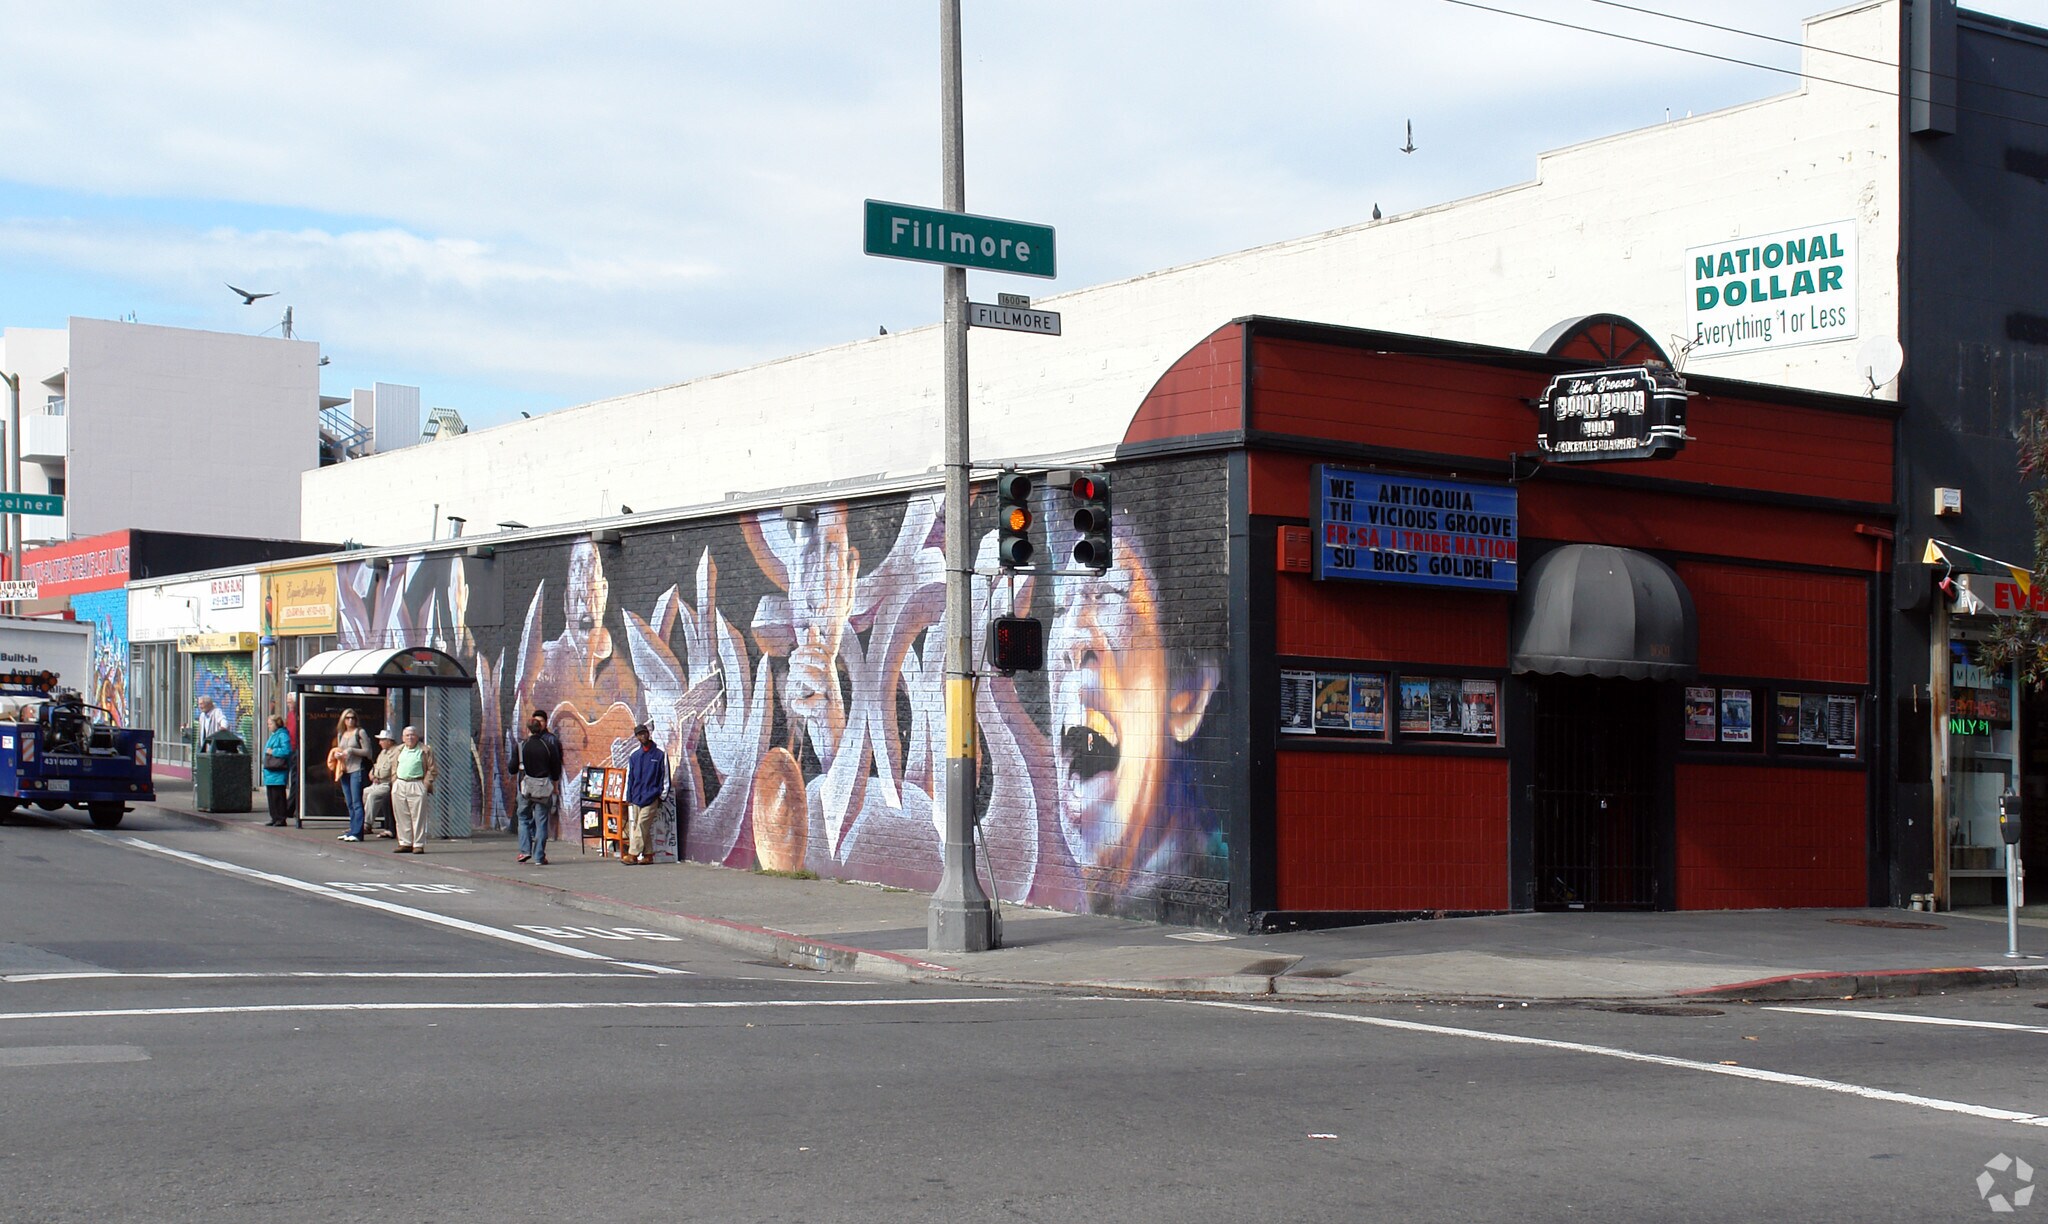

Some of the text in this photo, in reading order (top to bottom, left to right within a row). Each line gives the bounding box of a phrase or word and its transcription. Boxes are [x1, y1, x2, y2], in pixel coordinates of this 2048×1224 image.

[891, 216, 1031, 262] Fillmore
[1695, 233, 1844, 281] NATIONAL
[1001, 295, 1021, 306] 1600
[1696, 265, 1844, 311] DOLLAR
[979, 308, 1052, 330] FILLMORE
[1696, 313, 1772, 347] Everything
[1791, 312, 1805, 333] or
[1811, 304, 1846, 330] Less
[0, 497, 52, 511] einer
[1330, 478, 1473, 511] WE ANTIOQUIA
[1329, 501, 1512, 537] TH VICIOUS GROOVE
[1403, 531, 1451, 554] TRIBE
[1455, 535, 1517, 560] NATION
[1334, 547, 1493, 580] SU BROS GOLDEN
[1, 652, 38, 663] Built-In
[324, 881, 477, 895] STOP
[512, 924, 683, 941] BUS
